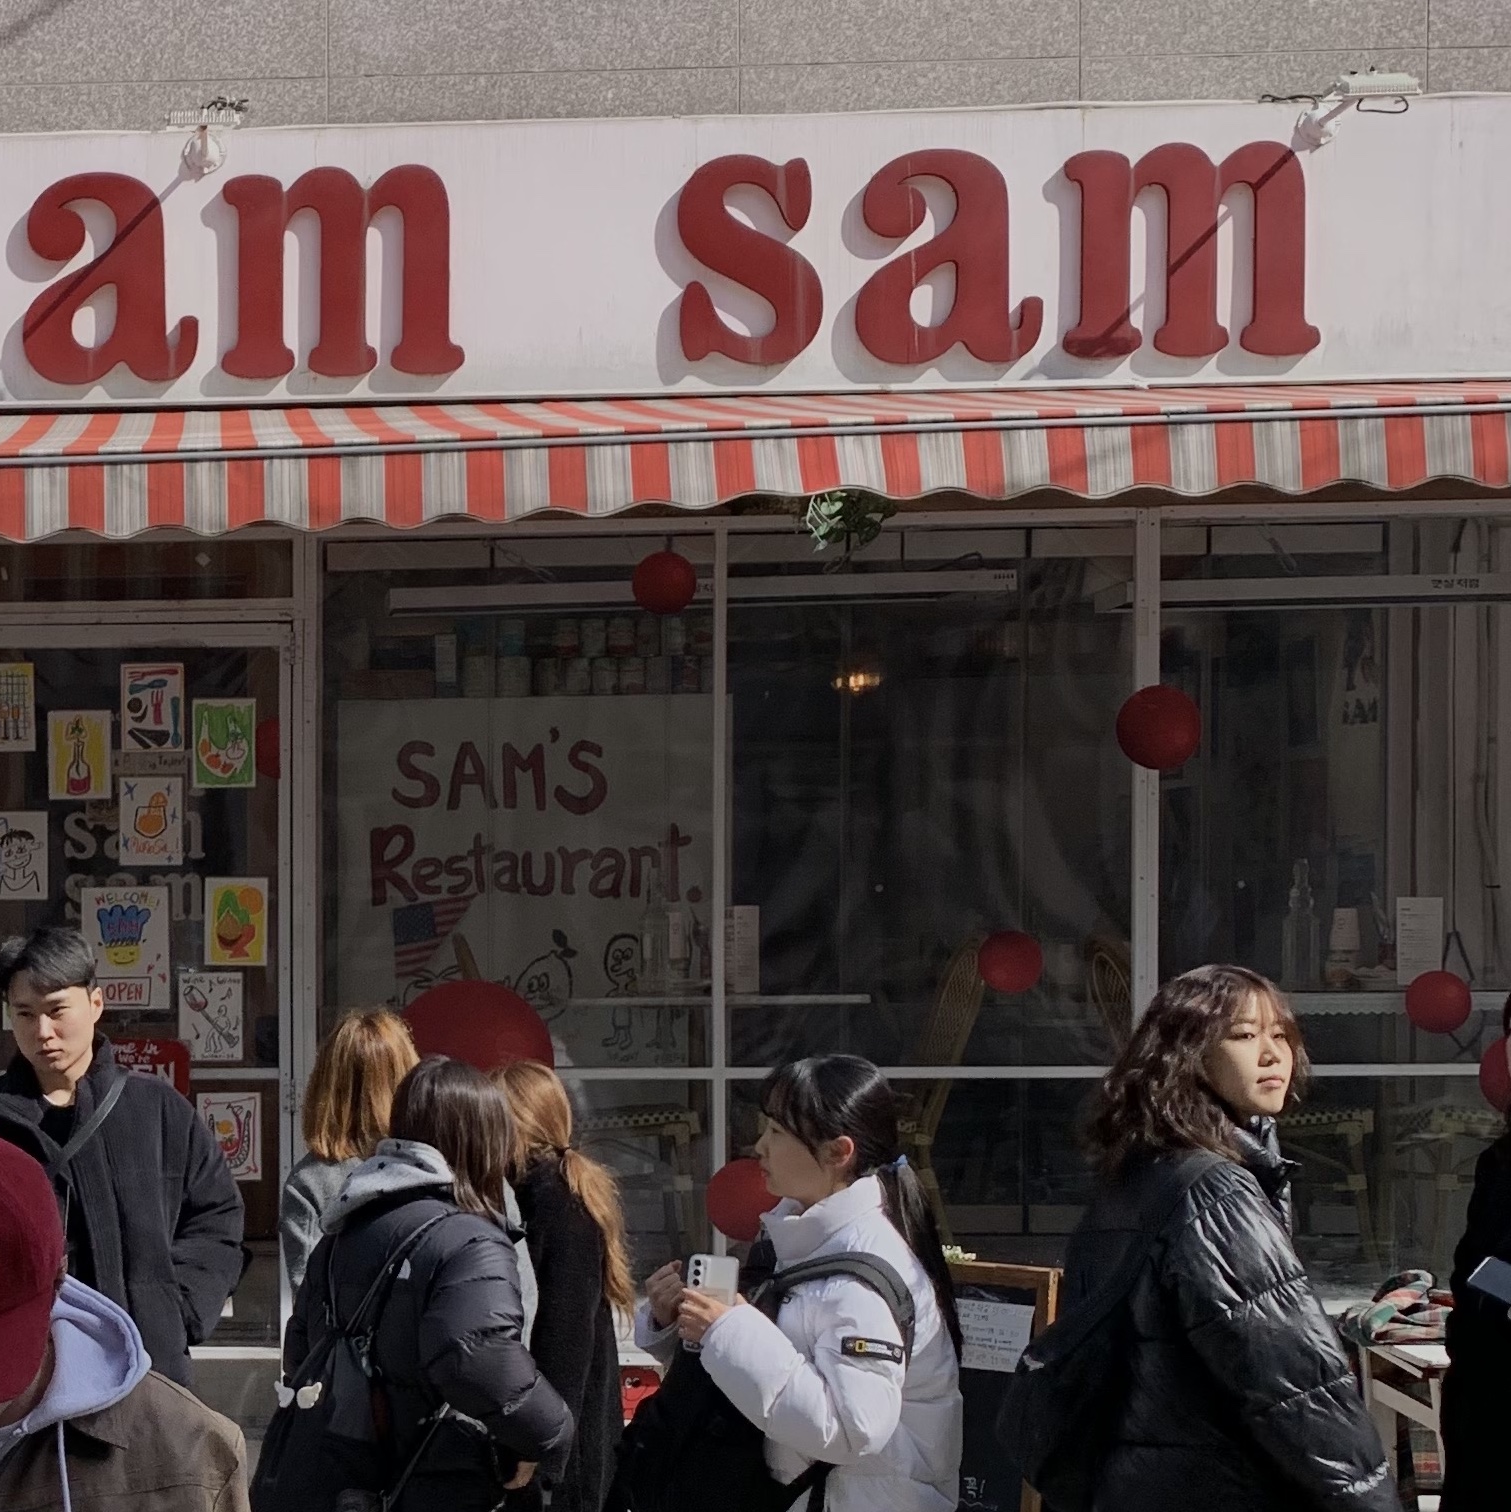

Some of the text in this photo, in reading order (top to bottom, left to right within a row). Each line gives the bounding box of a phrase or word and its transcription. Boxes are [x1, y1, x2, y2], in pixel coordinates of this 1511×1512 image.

[676, 144, 1321, 366] sam
[392, 727, 609, 816] SAM'S
[95, 891, 160, 911] WELCOME!
[106, 982, 144, 1001] OPEN
[141, 1039, 163, 1055] in
